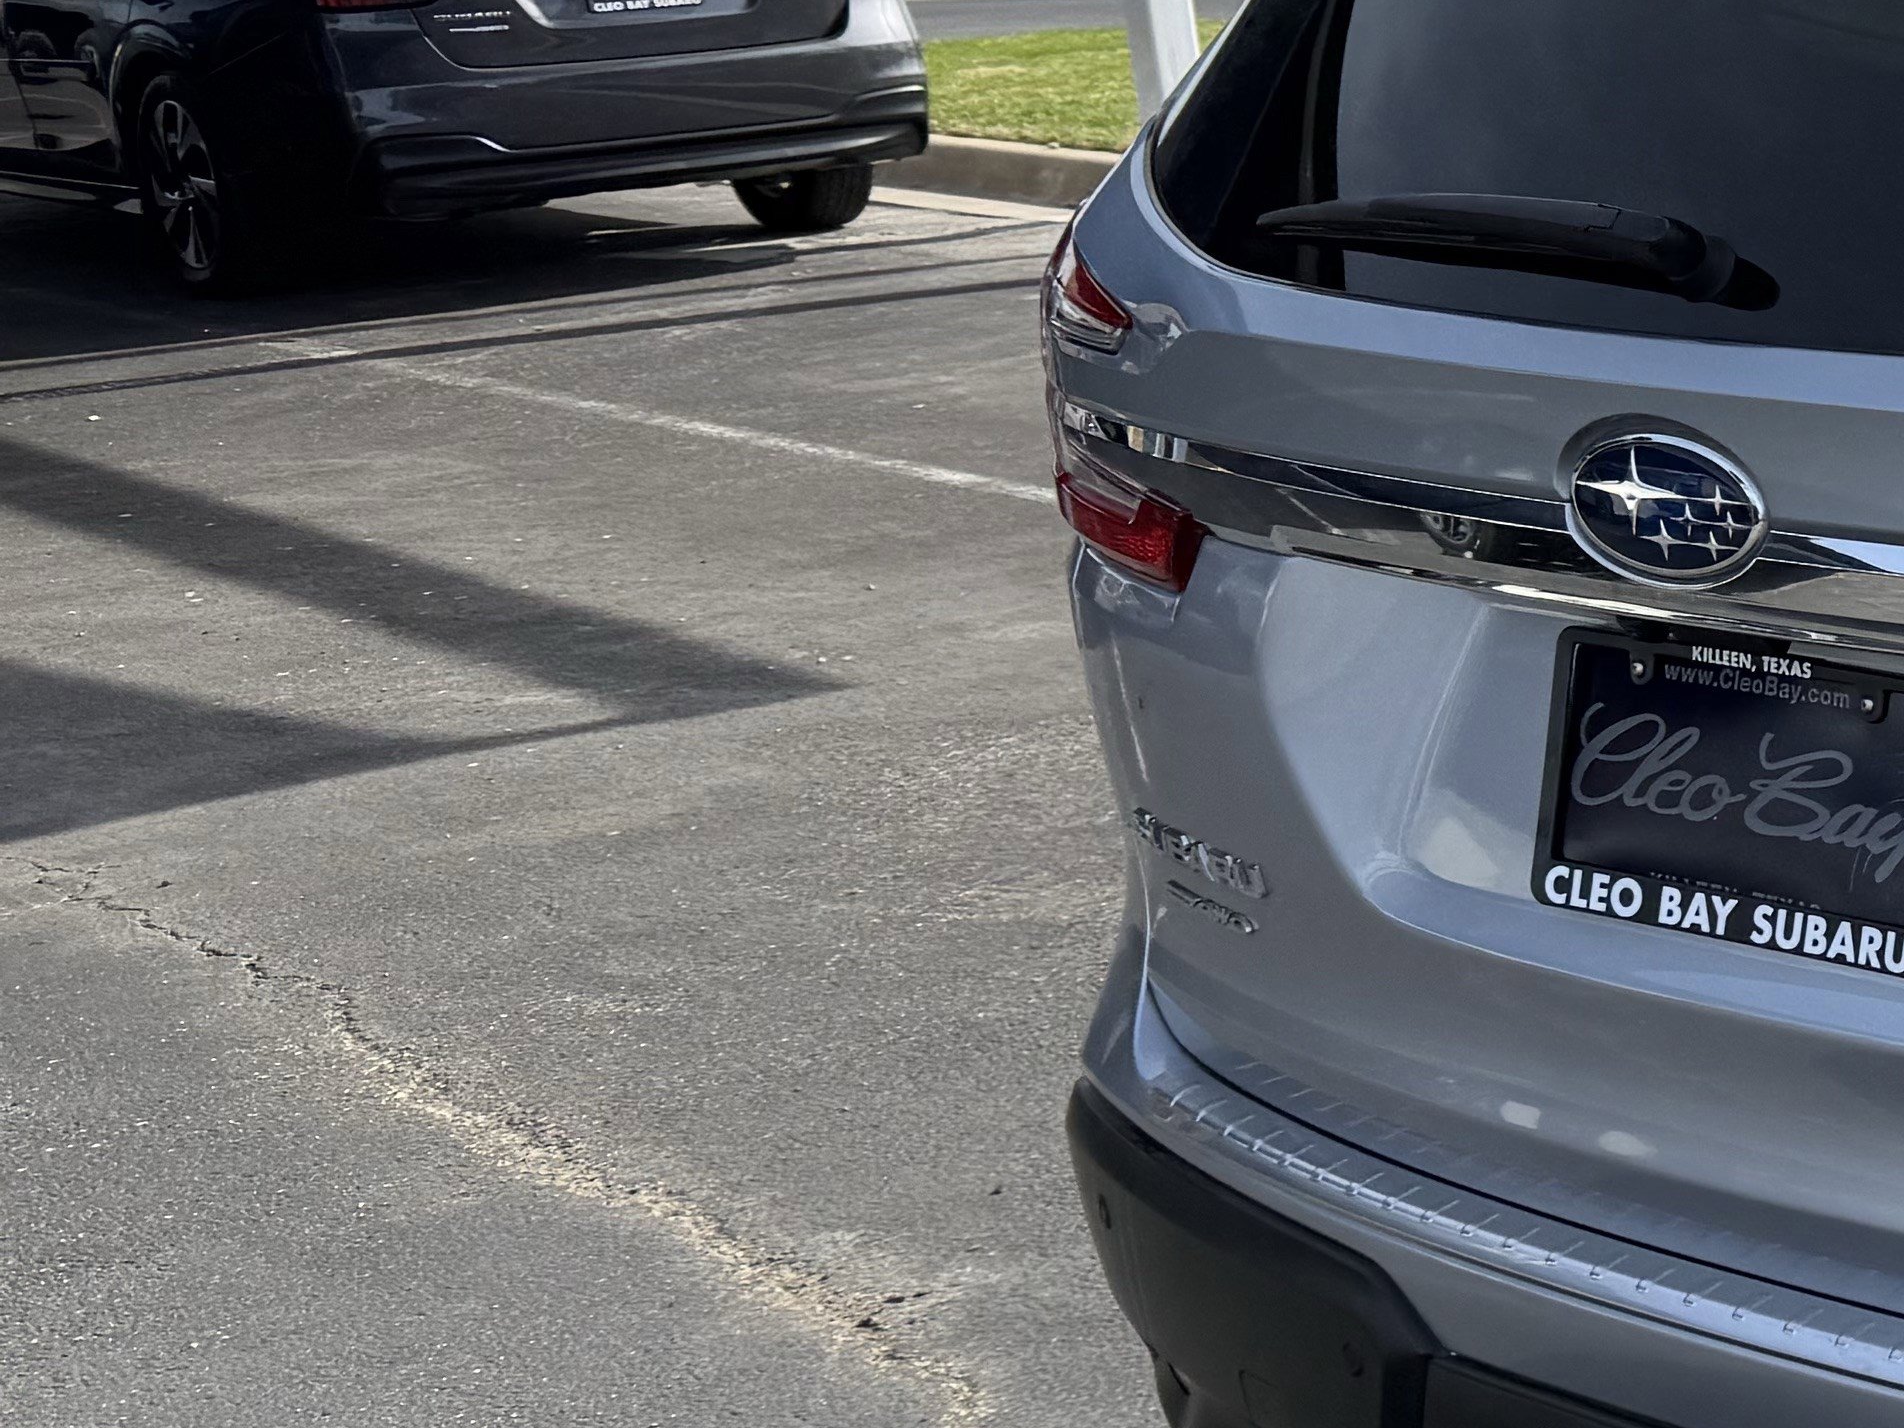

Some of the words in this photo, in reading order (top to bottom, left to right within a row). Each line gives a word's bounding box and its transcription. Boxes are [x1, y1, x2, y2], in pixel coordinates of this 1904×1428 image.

[593, 1, 625, 12] CLEO
[626, 0, 650, 10] BAY
[1663, 661, 1850, 709] www.CleoBay.com
[1691, 645, 1757, 673] KILLEEN,
[1761, 653, 1812, 680] TEXAS
[1571, 702, 1746, 822] Cleo
[1544, 865, 1643, 920] CLEO
[1658, 885, 1738, 936] BAY
